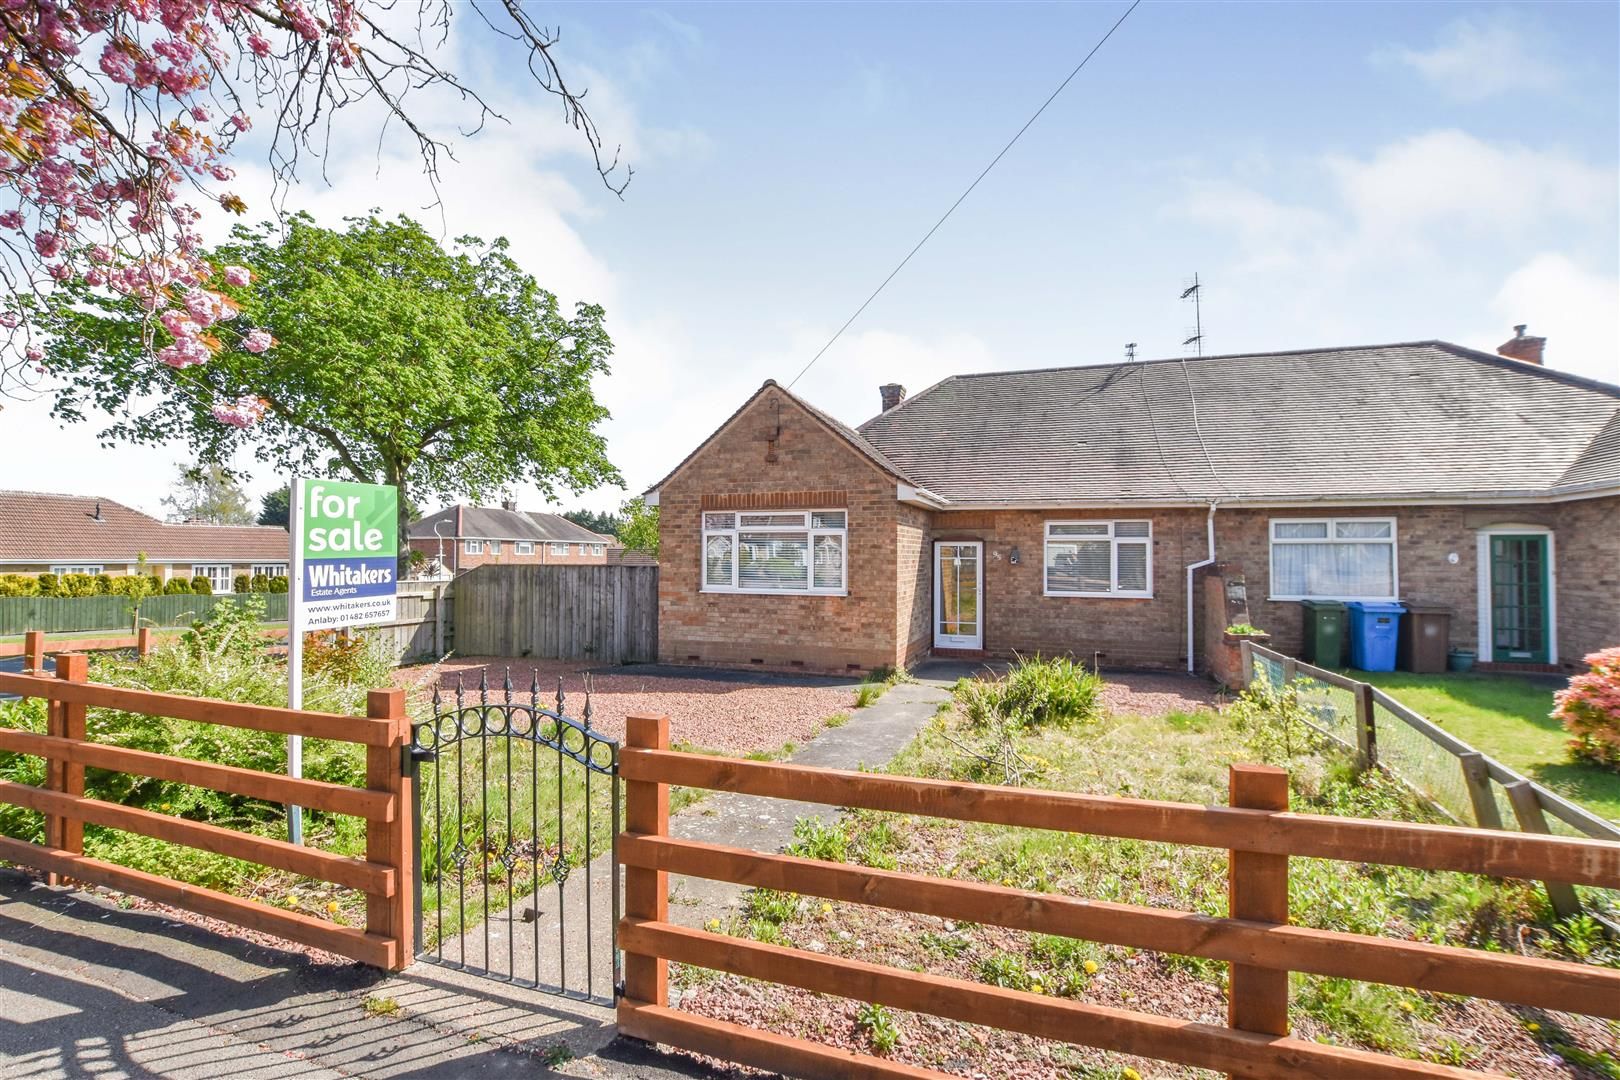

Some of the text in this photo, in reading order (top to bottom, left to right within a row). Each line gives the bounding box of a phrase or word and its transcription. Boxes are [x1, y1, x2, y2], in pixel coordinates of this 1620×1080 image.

[310, 485, 361, 519] for
[308, 520, 384, 552] sale
[308, 563, 392, 588] Whitakers
[311, 586, 358, 597] Estate Agents
[308, 599, 391, 613] www.whitakers.co.uk
[308, 609, 390, 625] Anlaby: 01482 657657
